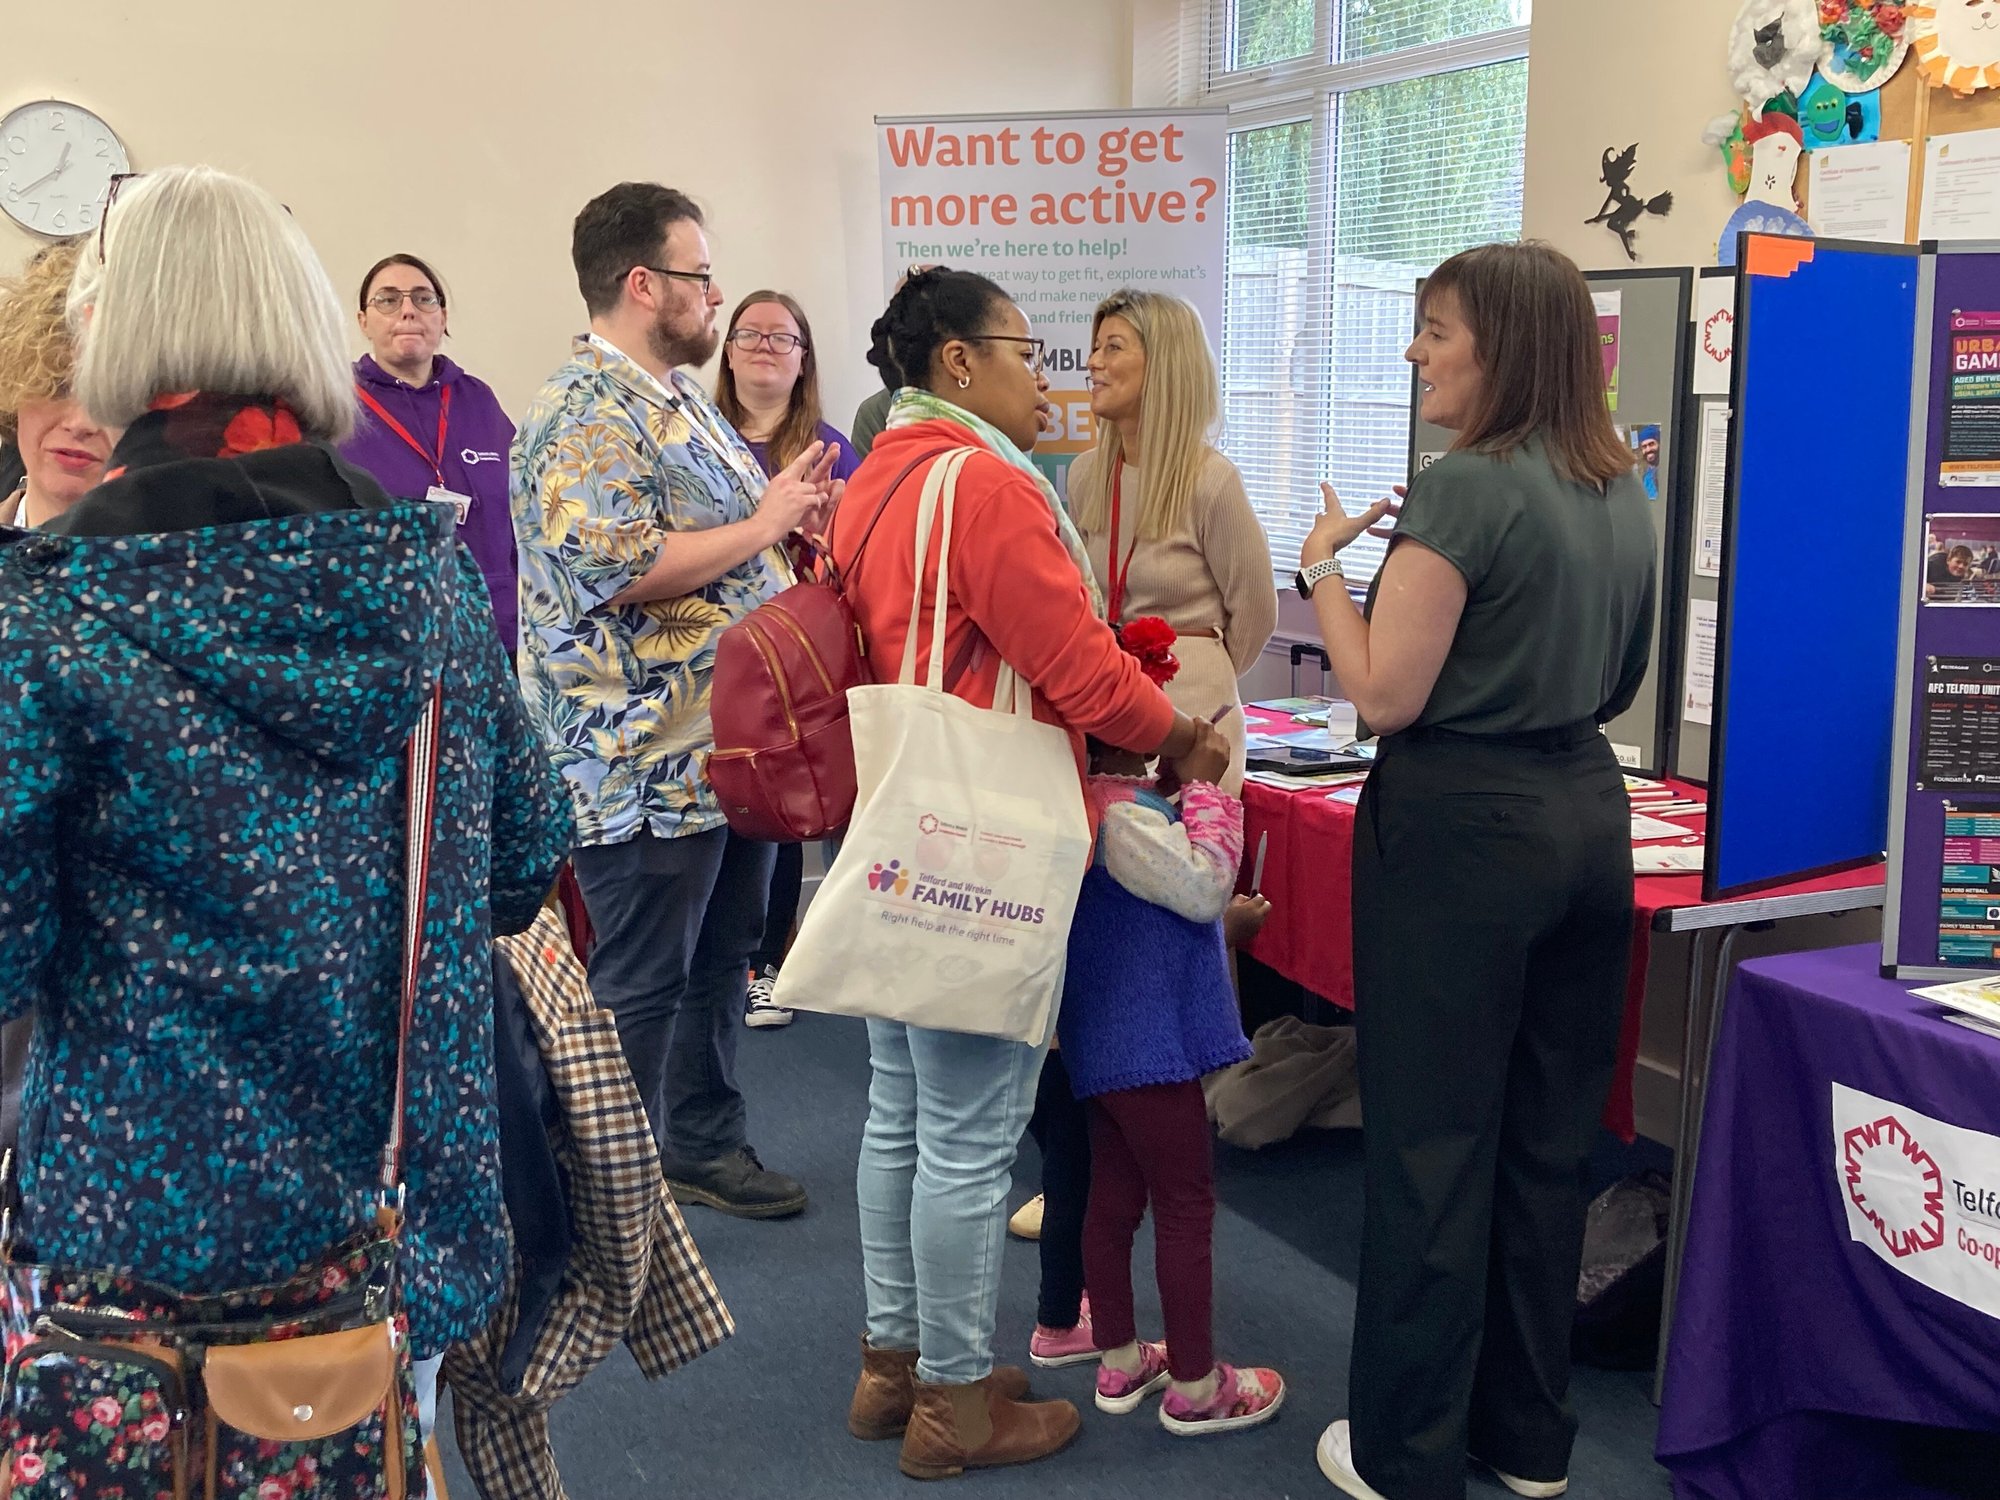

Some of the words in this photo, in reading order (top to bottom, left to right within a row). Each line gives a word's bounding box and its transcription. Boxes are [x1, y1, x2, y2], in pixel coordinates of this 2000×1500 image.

[886, 126, 1021, 167] Want
[1030, 126, 1086, 165] to
[1096, 123, 1184, 177] get
[890, 193, 1018, 227] more
[1029, 178, 1217, 225] active?
[896, 242, 942, 258] Then
[946, 239, 1001, 257] we're
[1004, 240, 1049, 257] here
[1053, 242, 1074, 256] to
[1078, 238, 1128, 259] help!
[1012, 271, 1039, 284] way
[1042, 270, 1056, 281] to
[1059, 270, 1080, 284] get
[1084, 267, 1104, 282] fit,
[1106, 267, 1158, 283] explore
[1160, 265, 1207, 280] what's
[1012, 290, 1037, 302] and
[1040, 290, 1078, 302] make
[1080, 292, 1107, 302] new
[1030, 312, 1056, 324] and
[1059, 311, 1092, 324] frien
[1599, 333, 1615, 345] ns
[1040, 349, 1089, 371] MBL
[1928, 683, 1945, 694] AFC
[1946, 683, 1981, 695] TELFORD
[1615, 754, 1637, 763] co.uk
[919, 872, 947, 887] Telford
[948, 880, 963, 891] and
[965, 883, 992, 896] Wrekin
[912, 884, 988, 914] FAMILY
[990, 900, 1045, 924] HUBS
[880, 911, 909, 925] Right
[911, 916, 934, 930] help
[935, 924, 947, 934] at
[948, 925, 965, 937] the
[967, 930, 991, 942] right
[993, 935, 1015, 946] time
